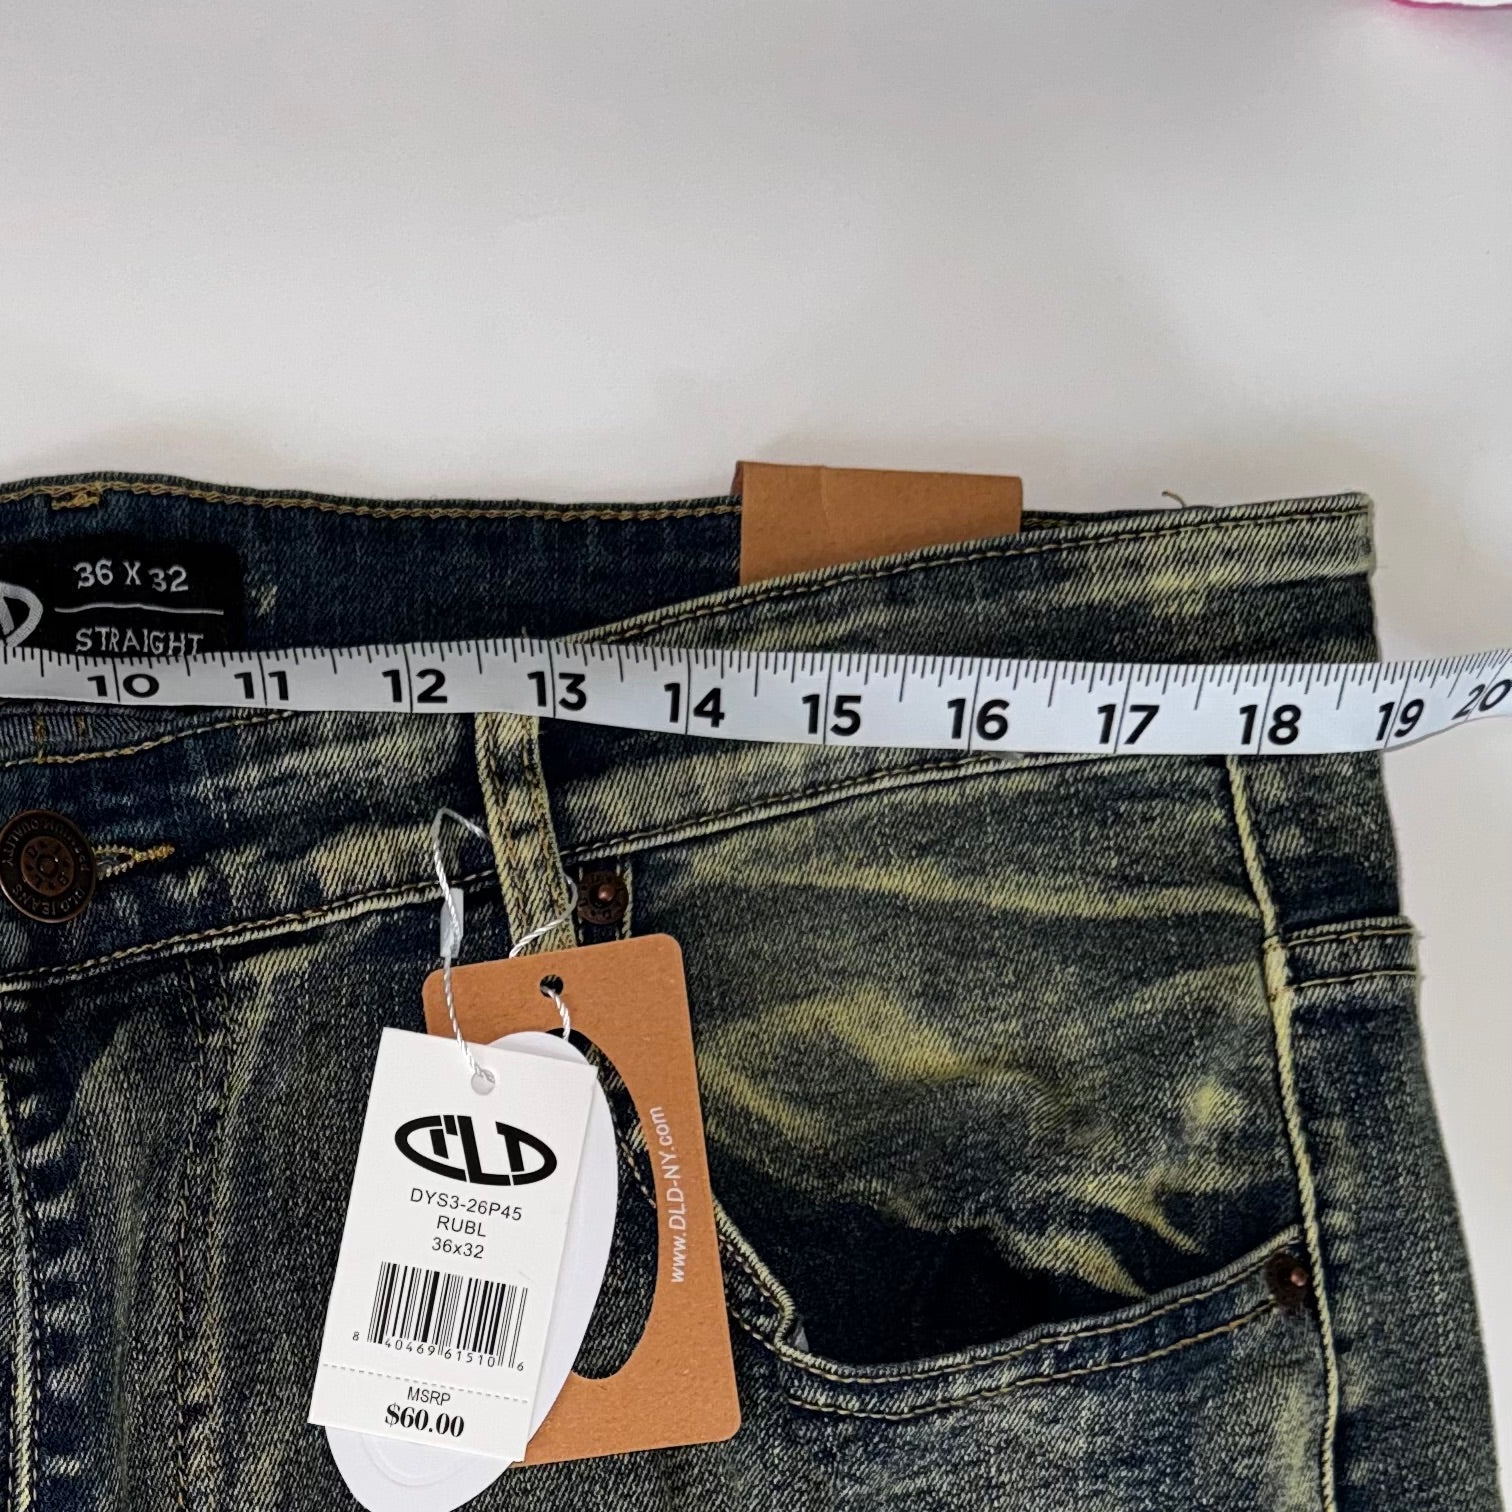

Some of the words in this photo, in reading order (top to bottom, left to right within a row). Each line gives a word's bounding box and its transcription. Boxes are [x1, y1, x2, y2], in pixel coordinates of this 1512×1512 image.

[73, 560, 113, 590] 36
[148, 566, 189, 592] 32
[75, 627, 204, 657] STRAIGHT
[87, 673, 160, 699] 10
[233, 670, 289, 701] 11
[382, 669, 448, 704] 12
[526, 671, 588, 711] 13
[663, 682, 725, 729] 14
[801, 694, 862, 736] 15
[947, 698, 1010, 741] 16
[1096, 703, 1160, 745] 17
[1238, 704, 1301, 747] 18
[1375, 698, 1425, 742] 19
[1451, 679, 1512, 721] 20
[410, 1187, 522, 1221] DYS3-26P45
[649, 1106, 687, 1283] www.DLD-NY.com
[436, 1215, 486, 1237] RUBL
[431, 1237, 485, 1259] 36x32
[407, 1386, 451, 1406] MSRP
[384, 1402, 465, 1437] $60.00
